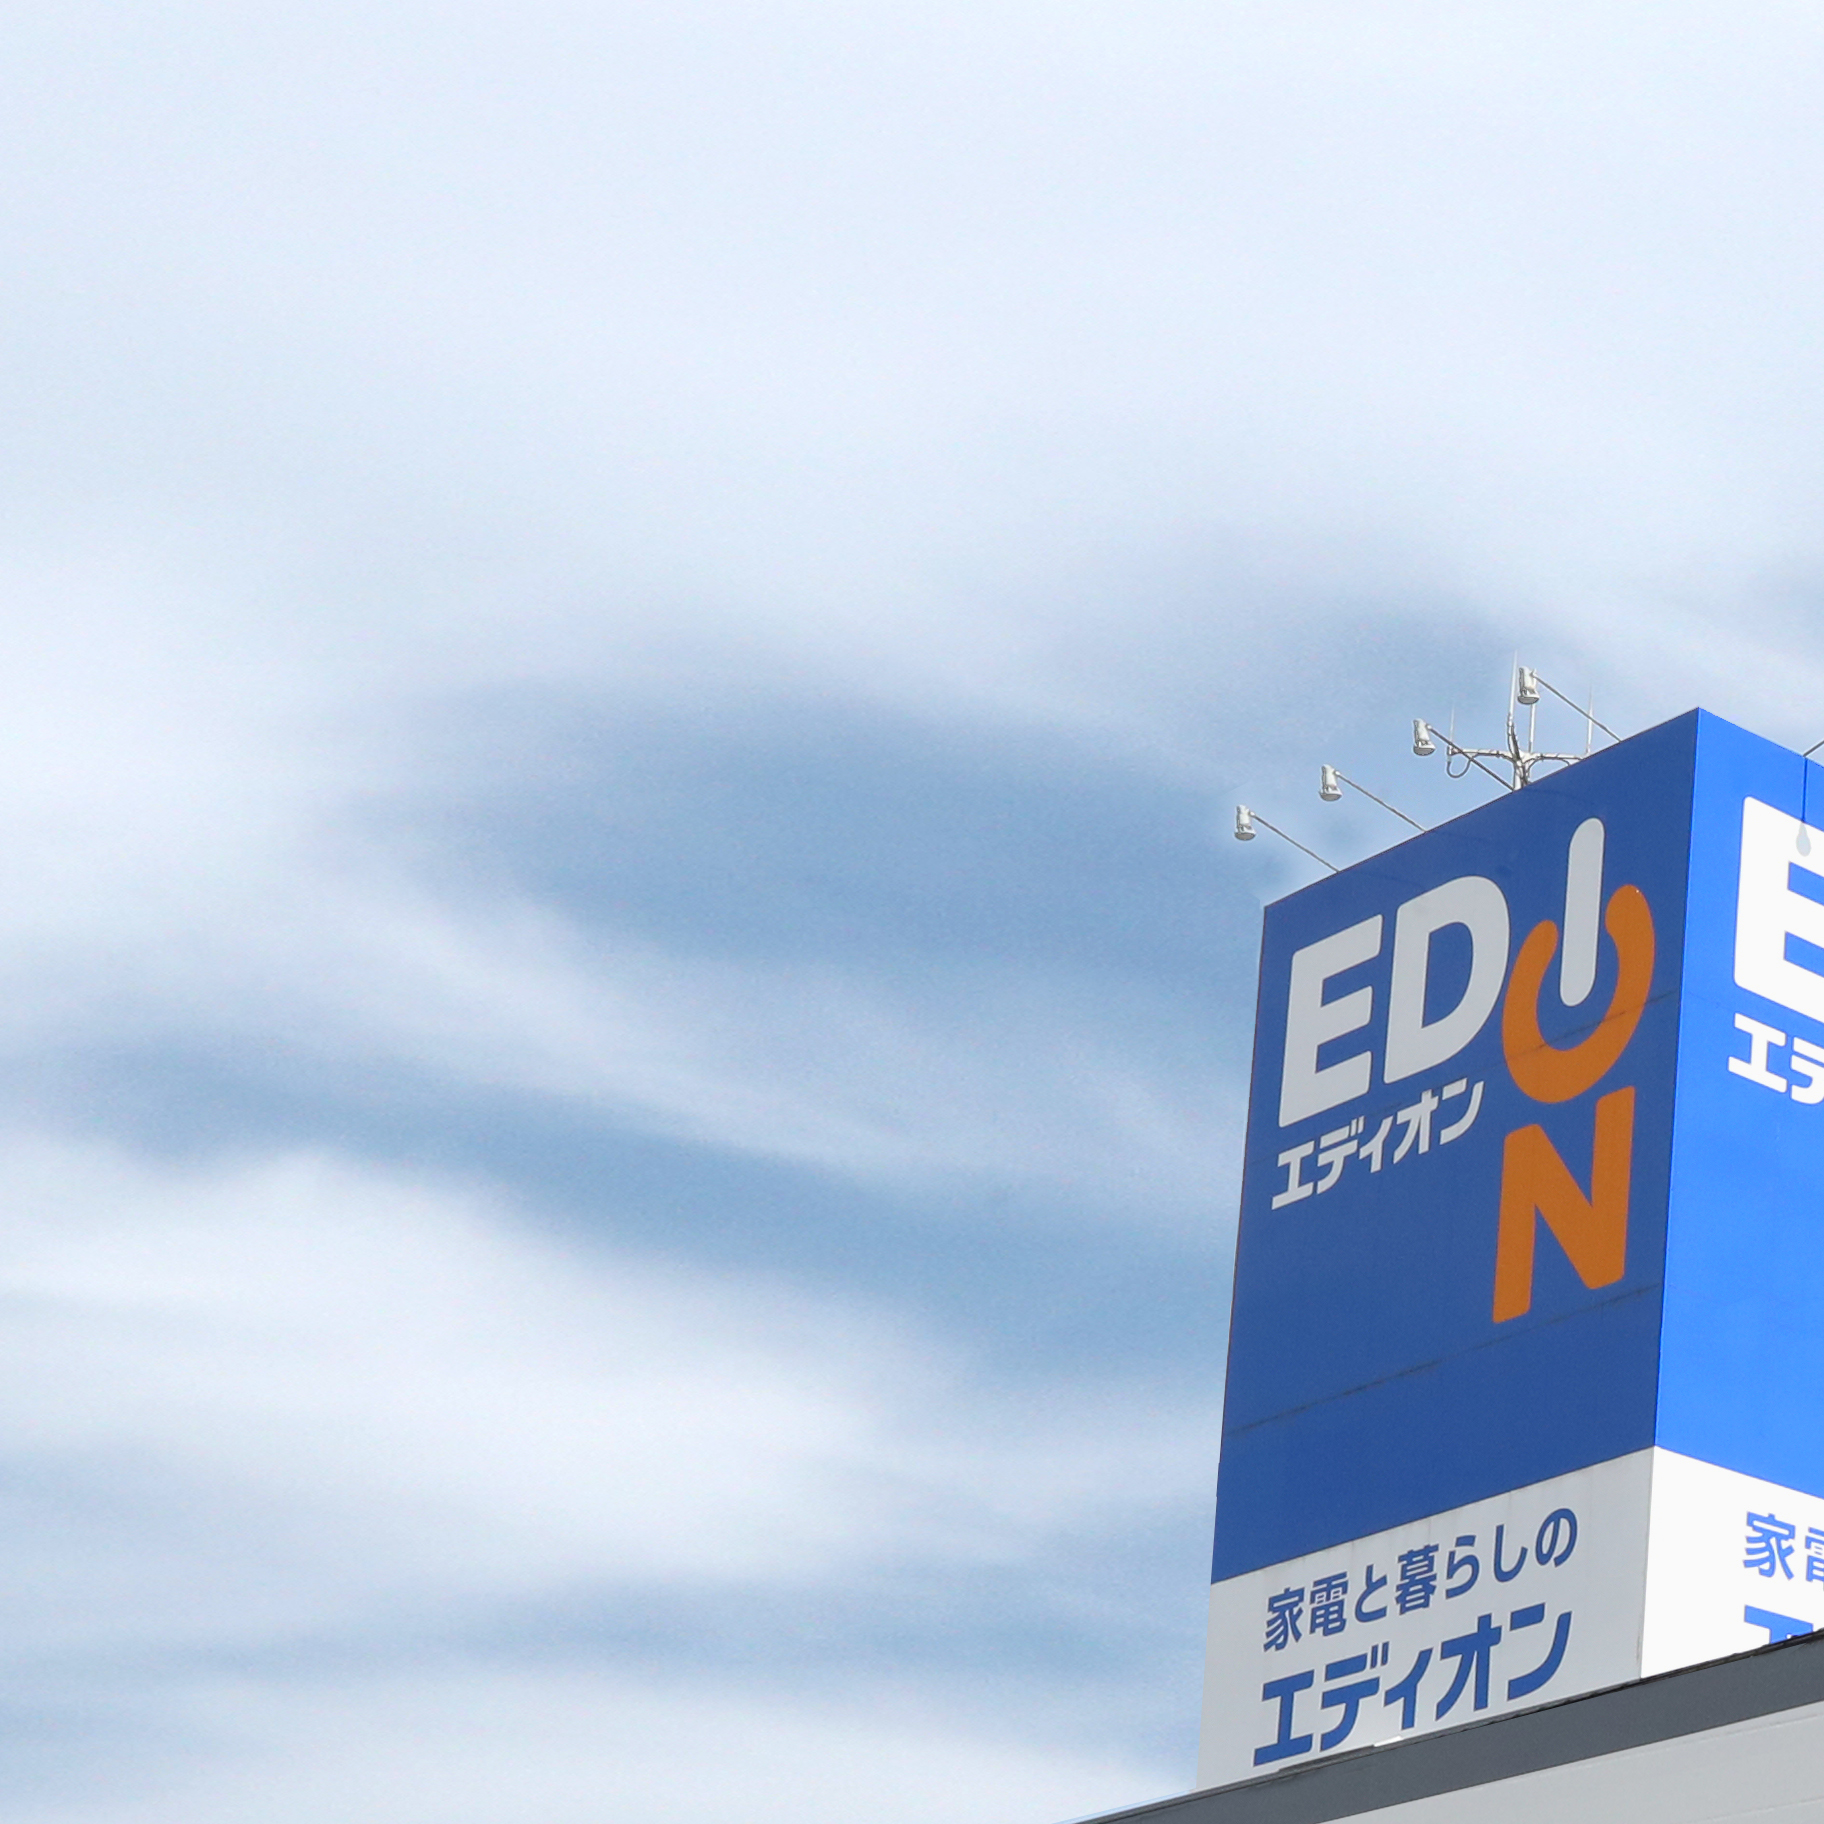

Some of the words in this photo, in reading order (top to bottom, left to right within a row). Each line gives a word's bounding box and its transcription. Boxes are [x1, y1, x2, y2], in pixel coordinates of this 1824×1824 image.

[1271, 1079, 1485, 1210] エディオン
[1263, 1507, 1578, 1652] 家電と暮らしの
[1253, 1602, 1572, 1766] エディオン
